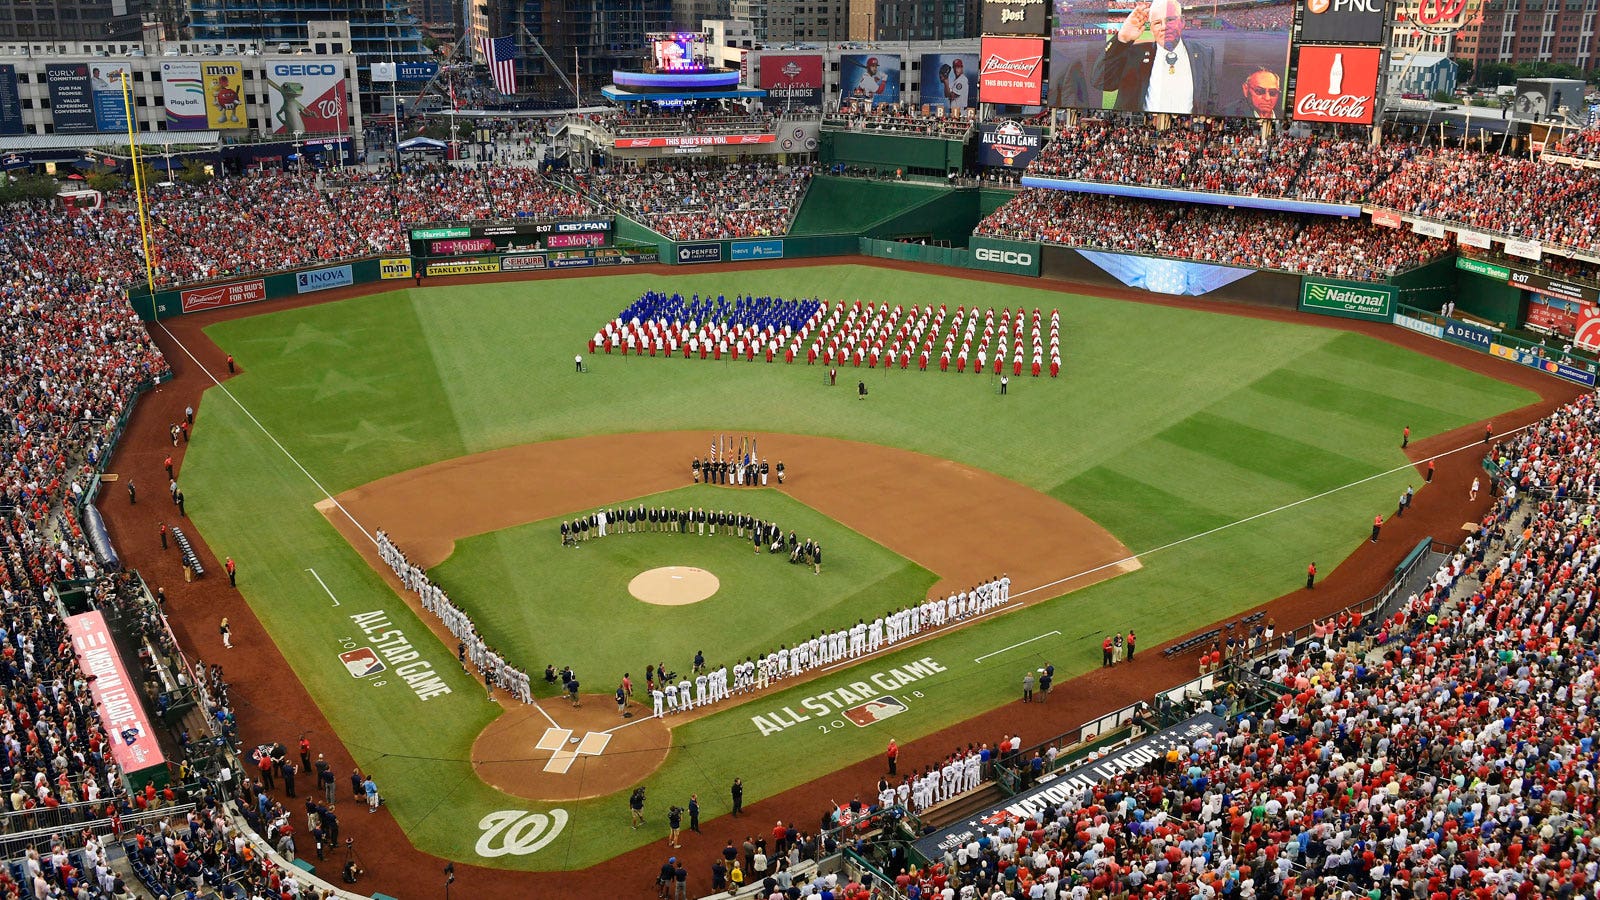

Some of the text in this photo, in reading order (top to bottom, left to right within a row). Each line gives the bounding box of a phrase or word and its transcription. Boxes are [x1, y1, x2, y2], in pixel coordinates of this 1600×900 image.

[1334, 0, 1380, 12] PNC
[1002, 9, 1024, 24] Post
[275, 64, 335, 76] GEICO
[986, 59, 1034, 71] Budweiser
[770, 89, 813, 97] MERCHANDISE
[1297, 93, 1371, 118] Coca-Cola
[983, 134, 1038, 146] ALL STAR GAME
[975, 248, 1031, 266] GEICO
[311, 270, 344, 283] INOVA
[1465, 262, 1507, 278] Harris Teeter
[1513, 273, 1528, 283] 8:07
[244, 283, 263, 292] BUD'S
[230, 294, 241, 302] FOR
[1326, 289, 1384, 306] National
[1457, 328, 1489, 344] DELTA
[1560, 368, 1588, 380] mastercard
[350, 610, 453, 701] ALL STAR GAME
[85, 647, 122, 690] AMERICAN
[751, 656, 947, 736] ALL STAR GAME
[101, 687, 137, 726] LEAGUE
[1005, 744, 1160, 819] NATIONAL LEAGUE
